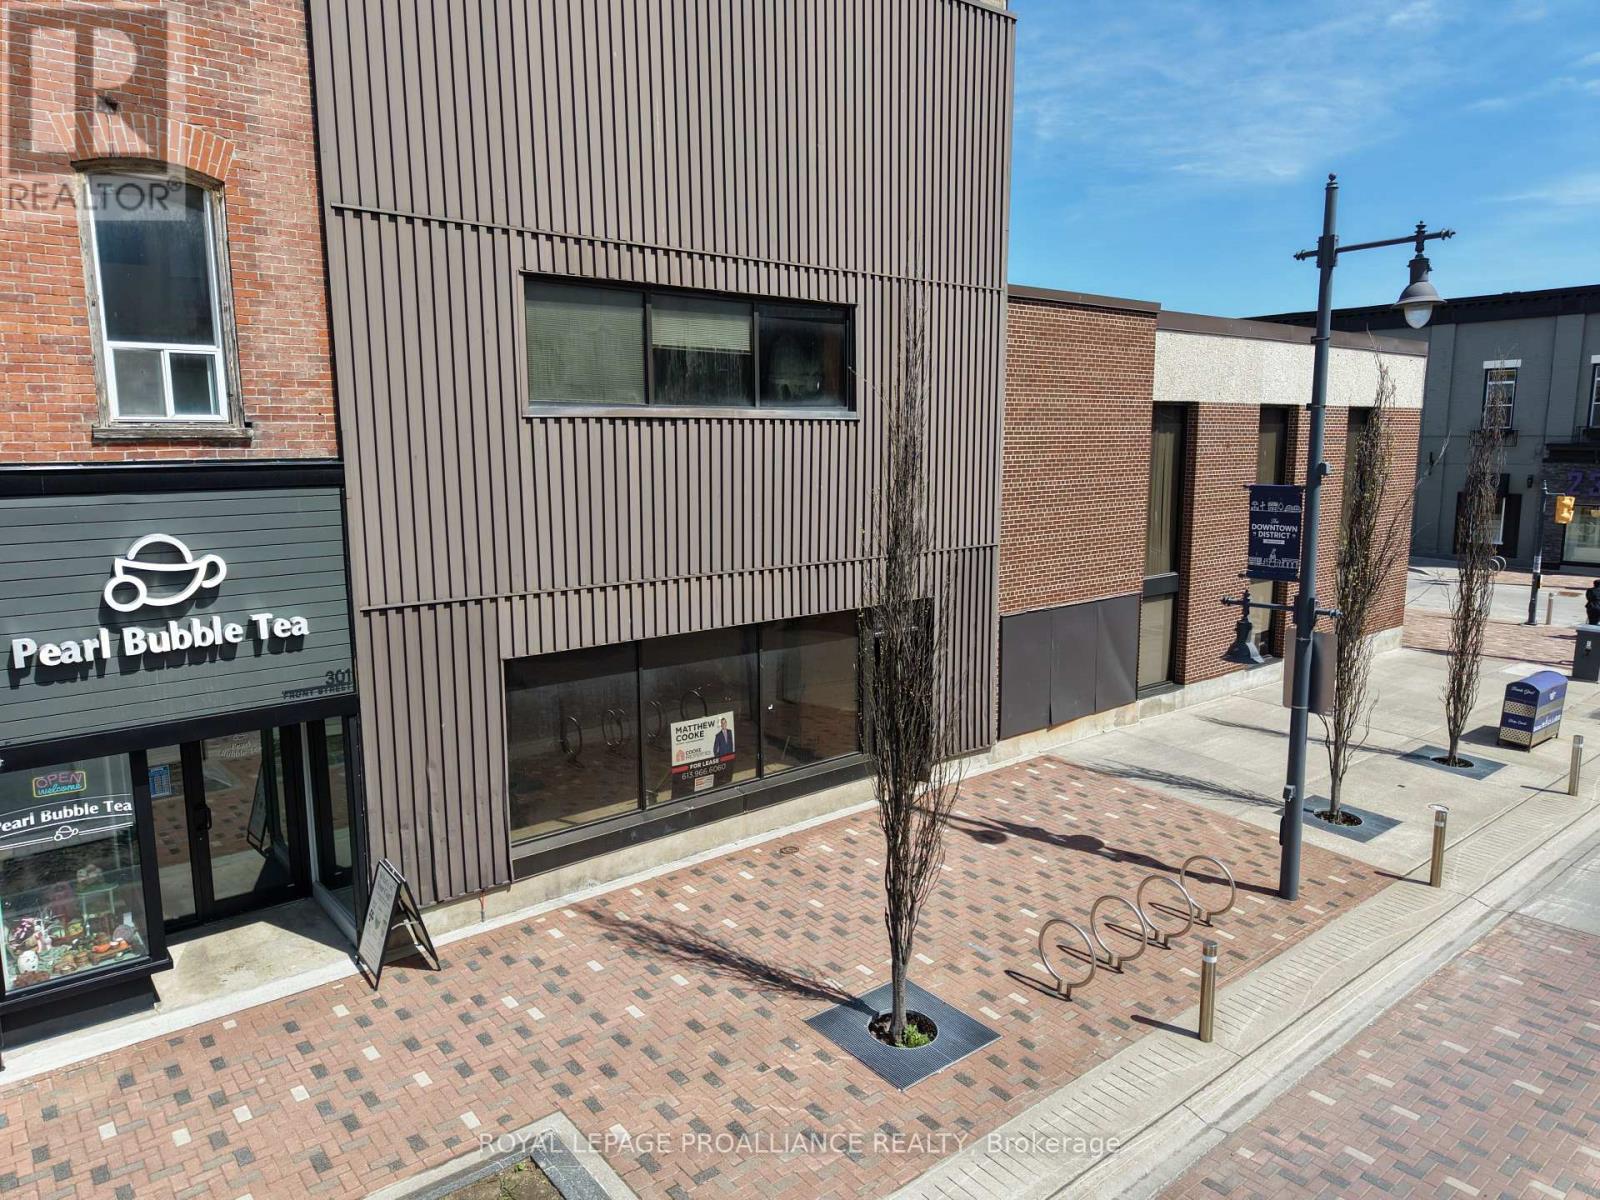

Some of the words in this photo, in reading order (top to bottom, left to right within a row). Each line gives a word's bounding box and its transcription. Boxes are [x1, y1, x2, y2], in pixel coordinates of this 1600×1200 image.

[1252, 523, 1298, 533] DOWNTOWN
[1258, 531, 1290, 539] DISTRICT
[12, 627, 112, 669] Pearl
[122, 615, 244, 656] Bubble
[249, 612, 310, 640] Tea
[325, 668, 351, 684] 301
[281, 688, 313, 699] FRONT
[318, 684, 353, 695] STREET
[675, 720, 715, 734] MATTHEW
[675, 730, 705, 742] COOKE
[702, 758, 720, 767] LEASE
[36, 772, 82, 788] OPEN
[38, 783, 82, 795] welcome
[0, 812, 35, 832] earl
[40, 802, 99, 823] Bubble
[103, 800, 133, 812] Tea
